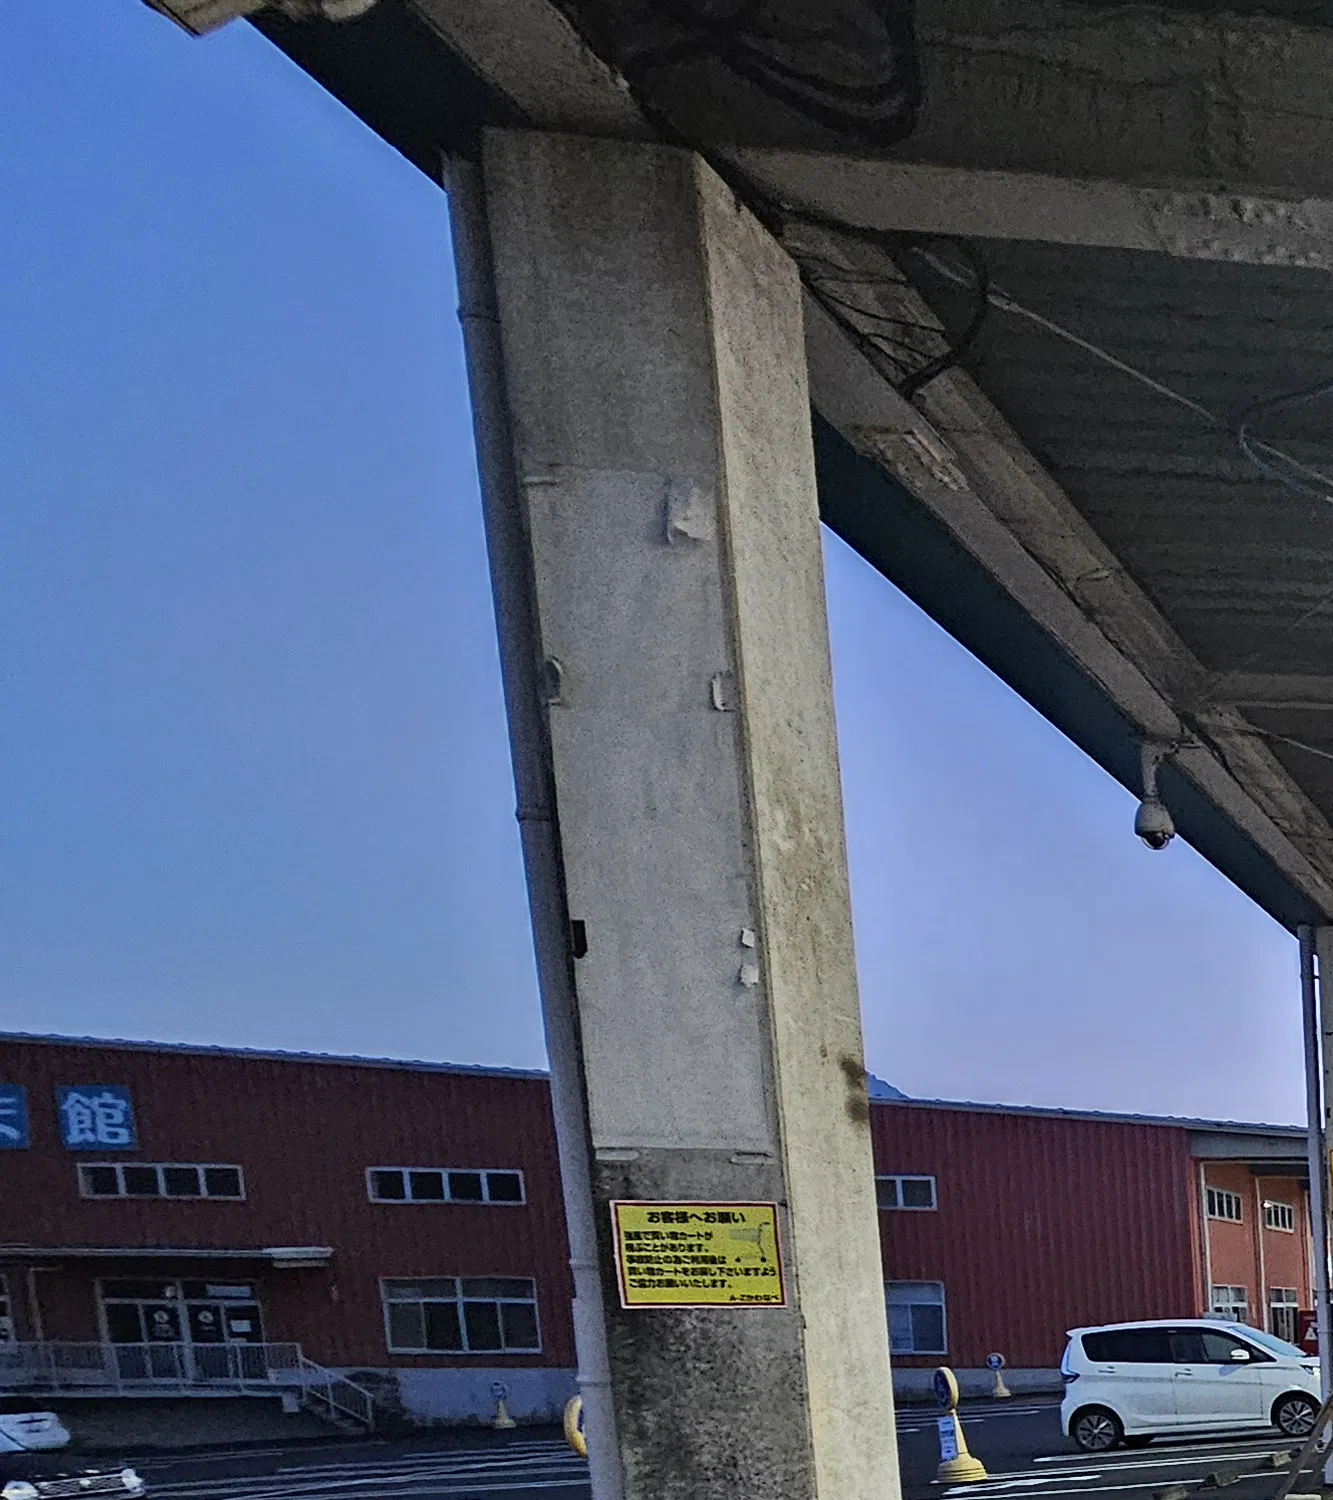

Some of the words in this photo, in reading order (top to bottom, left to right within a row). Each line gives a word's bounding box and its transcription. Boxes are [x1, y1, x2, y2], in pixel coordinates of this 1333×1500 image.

[647, 1211, 746, 1224] お客様へお願い
